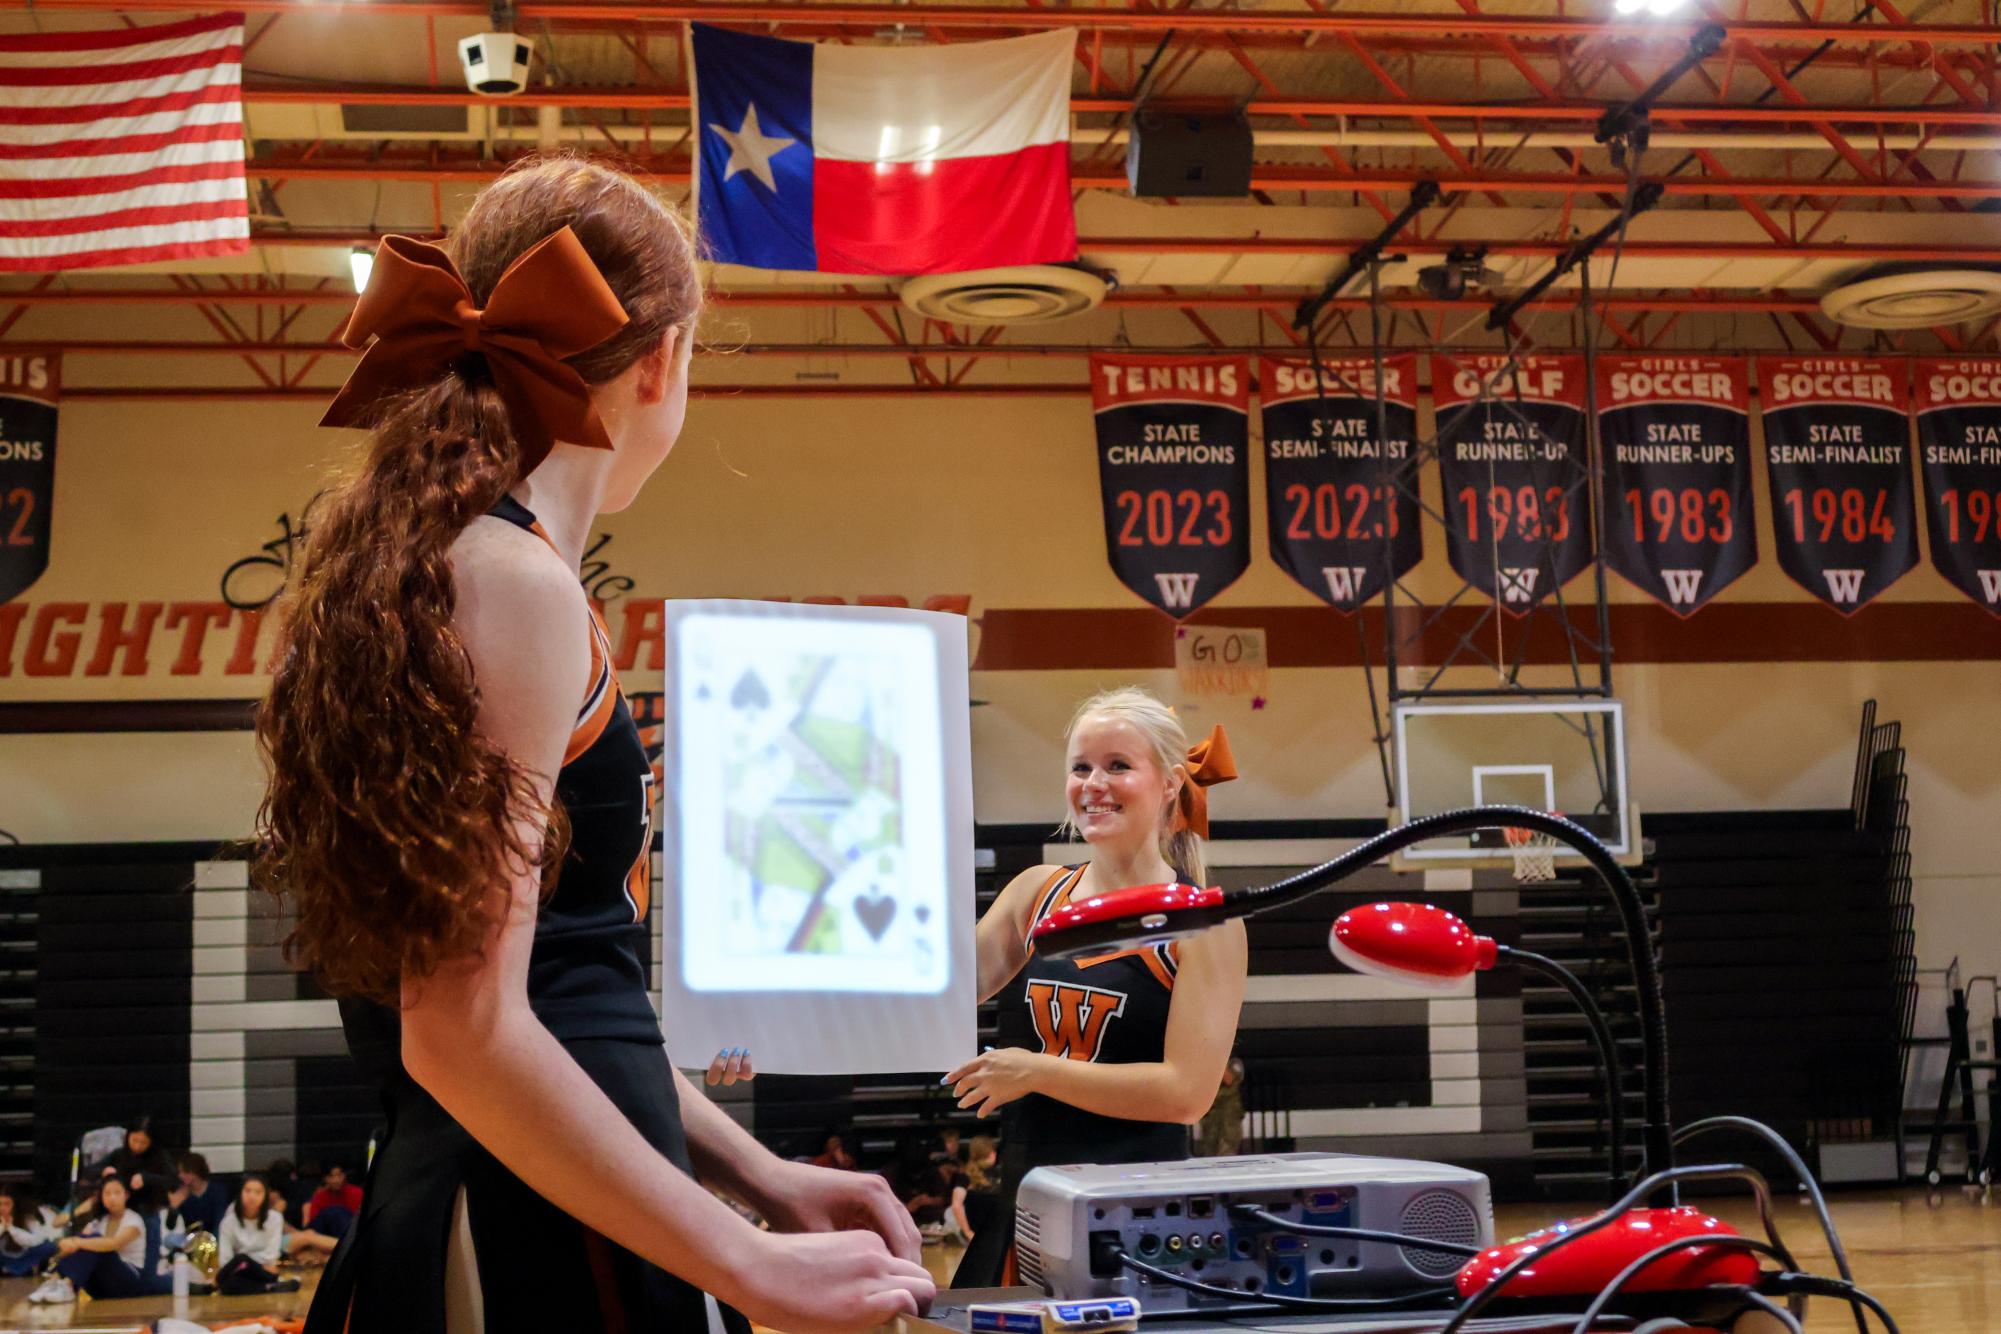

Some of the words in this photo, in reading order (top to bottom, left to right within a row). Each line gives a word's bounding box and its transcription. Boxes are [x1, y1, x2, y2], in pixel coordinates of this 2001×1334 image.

[1641, 359, 1700, 371] GIRLS
[1802, 361, 1860, 372] GIRLS
[1102, 365, 1238, 396] TENNIS
[1453, 370, 1564, 397] GOLF
[1611, 372, 1733, 400] SOCCER
[1772, 374, 1894, 401] SOCCER
[1144, 424, 1200, 442] STATE
[1311, 418, 1367, 437] SATE
[1647, 424, 1702, 442] STATE
[1809, 425, 1863, 443] STATE
[1107, 446, 1235, 464] CHAMPIONS
[1616, 446, 1735, 463] RUNNER-UPS
[1770, 447, 1902, 464] SEMI-FINALIST
[1117, 490, 1232, 545] 2023
[1285, 483, 1399, 540] 2023
[1458, 485, 1569, 542] 1983
[1625, 488, 1733, 543] 1983
[1784, 488, 1896, 543] 1984
[1154, 573, 1199, 607] W
[1661, 569, 1703, 603] W
[1822, 569, 1865, 602] W
[1192, 634, 1242, 663] GO
[1024, 978, 1128, 1064] W
